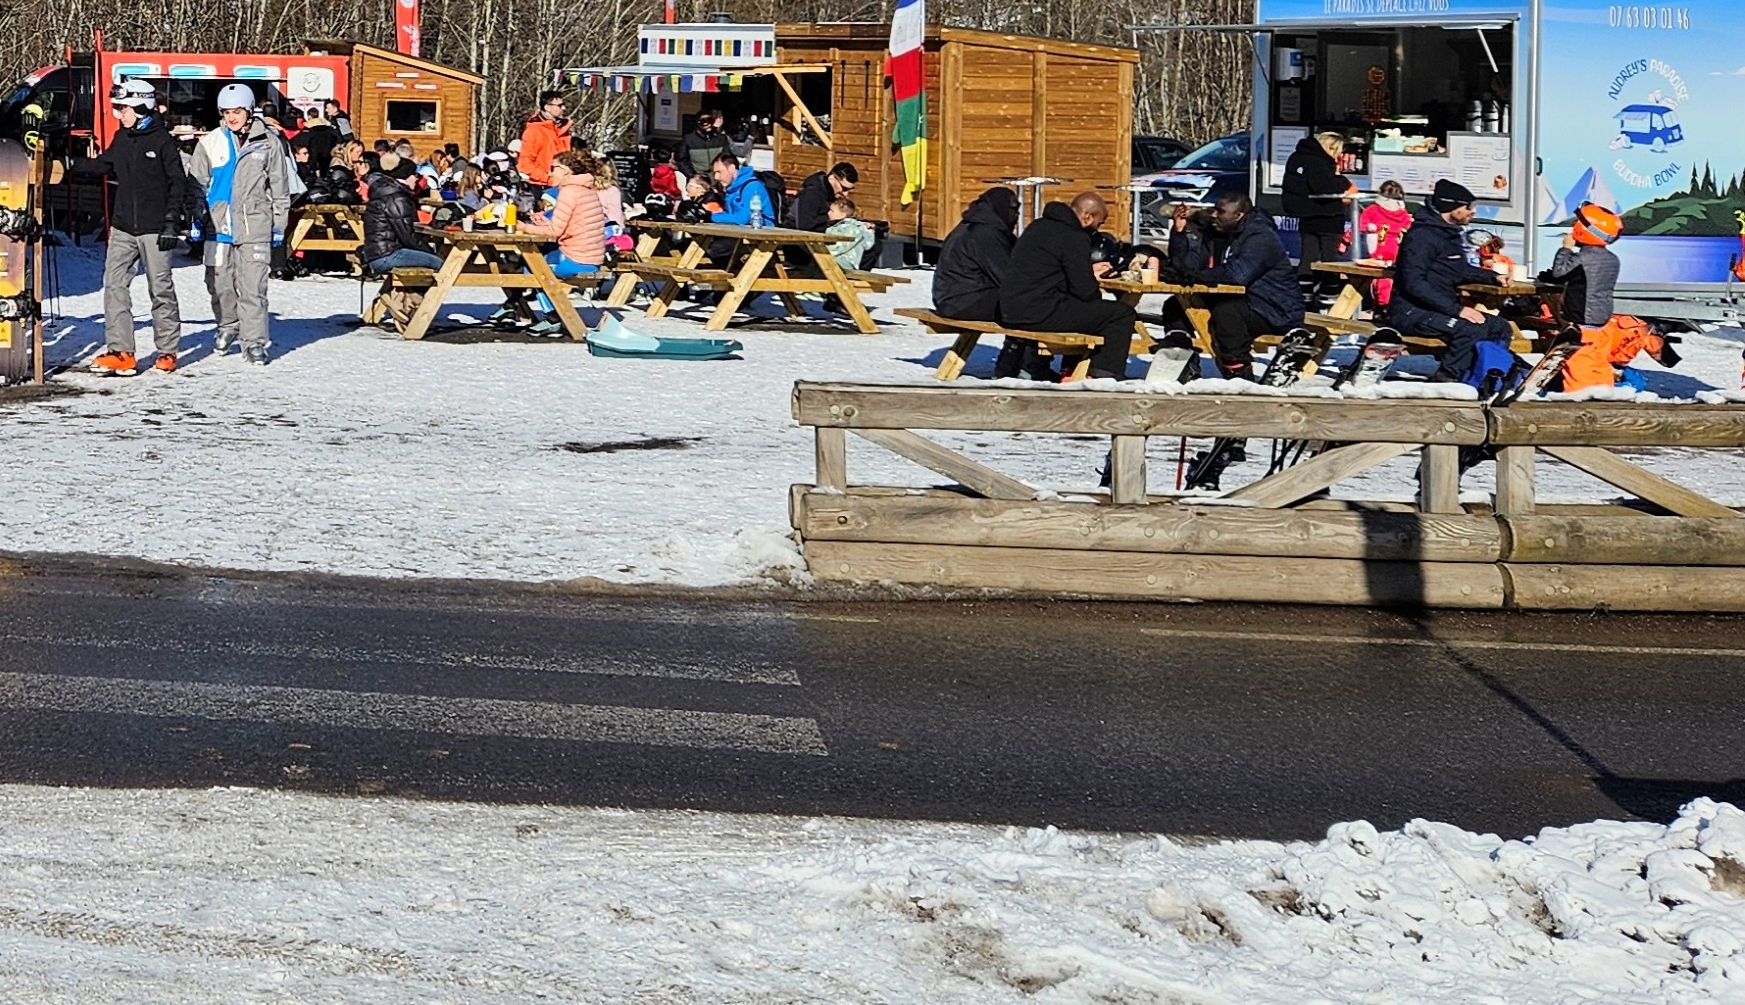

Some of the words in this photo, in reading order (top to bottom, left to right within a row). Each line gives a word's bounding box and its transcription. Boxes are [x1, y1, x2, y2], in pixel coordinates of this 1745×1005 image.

[1609, 5, 1622, 27] 07
[1627, 6, 1640, 28] 63
[1644, 6, 1657, 28] 03
[1661, 7, 1674, 29] 01
[1677, 7, 1690, 30] 46
[1608, 58, 1647, 101] AUDREY'S
[1612, 158, 1652, 188] BUDDHA
[1654, 162, 1681, 186] BOWL
